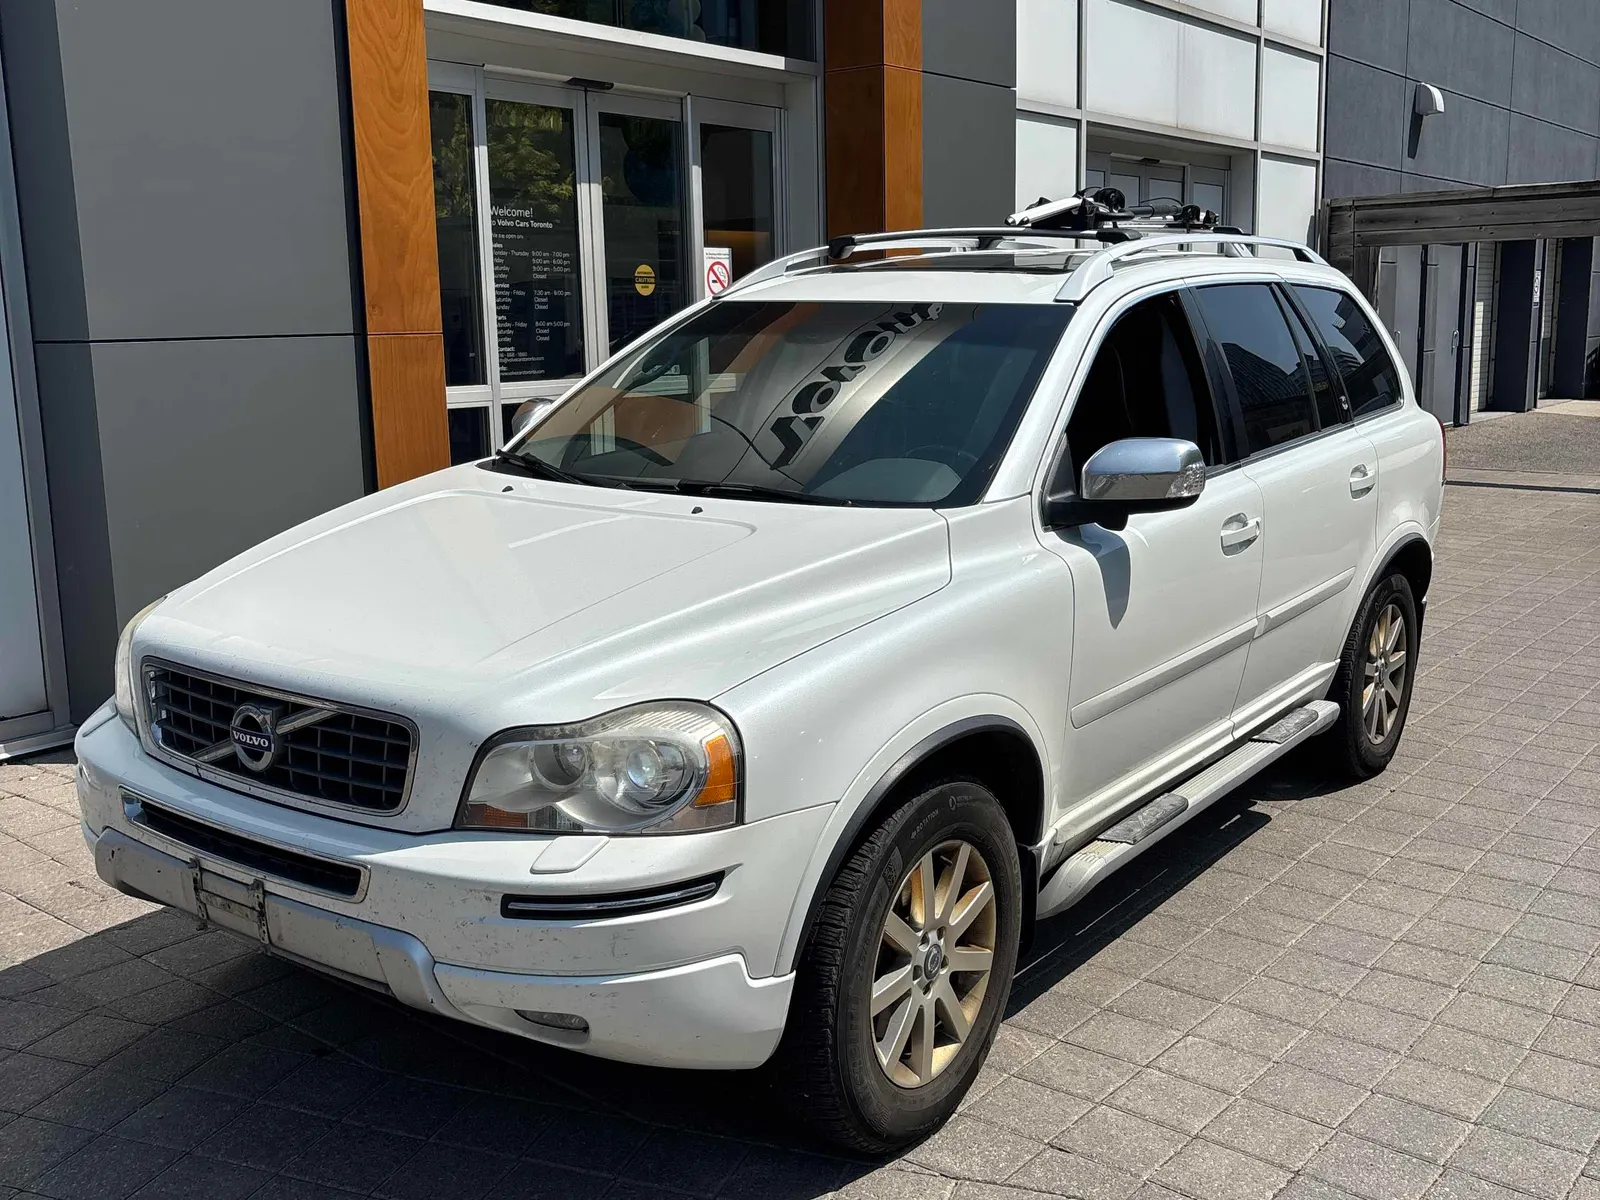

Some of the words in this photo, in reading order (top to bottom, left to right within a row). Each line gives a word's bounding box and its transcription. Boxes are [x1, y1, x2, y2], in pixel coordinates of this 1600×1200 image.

[491, 206, 533, 218] Welcome!
[530, 220, 553, 228] Toronto
[494, 250, 508, 258] onday
[232, 730, 269, 747] VOLVO
